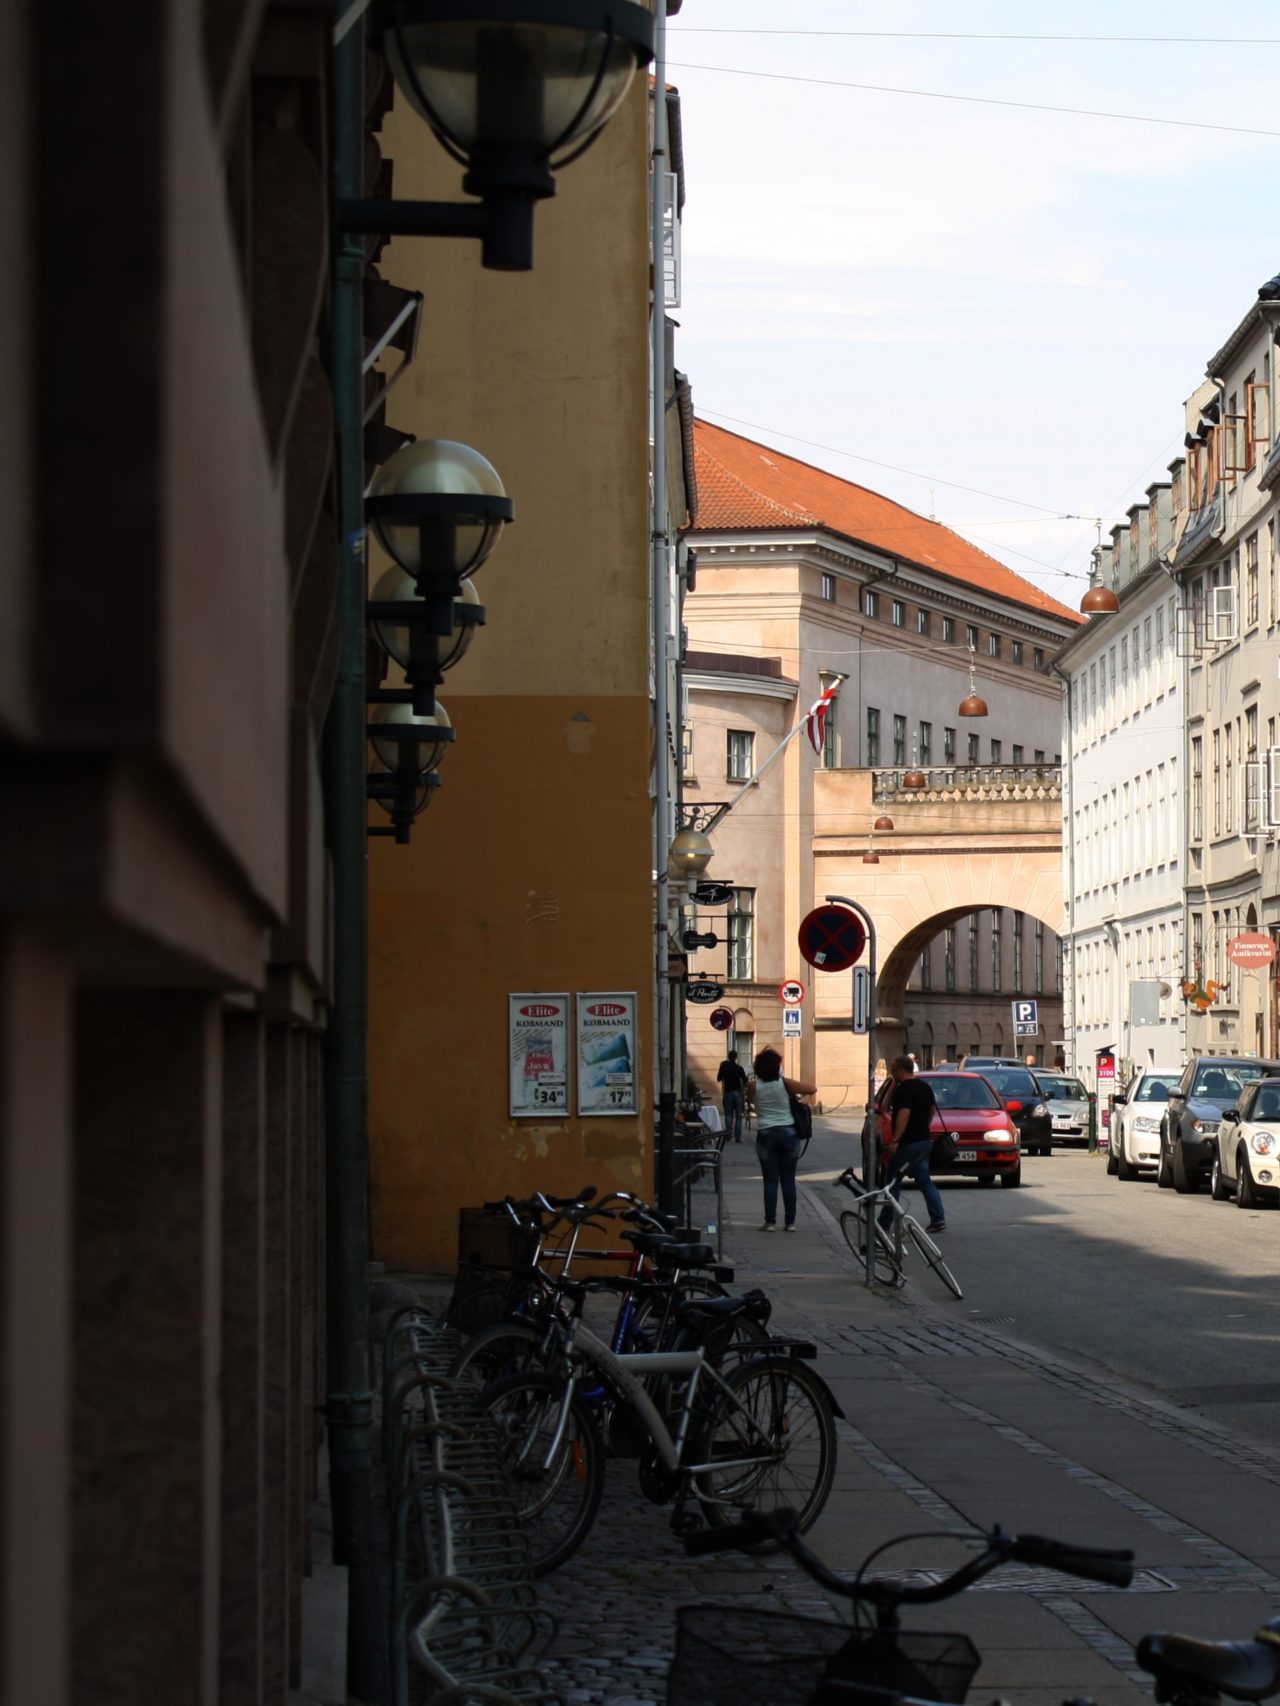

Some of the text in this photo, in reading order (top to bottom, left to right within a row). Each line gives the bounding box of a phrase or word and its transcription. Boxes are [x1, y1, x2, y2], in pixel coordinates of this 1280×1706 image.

[1234, 942, 1270, 951] Finnerups
[527, 1006, 554, 1016] Elite
[595, 1005, 621, 1015] Elite
[1019, 1003, 1032, 1021] P
[1100, 1058, 1107, 1066] P
[541, 1090, 557, 1103] 34
[610, 1090, 624, 1103] 17
